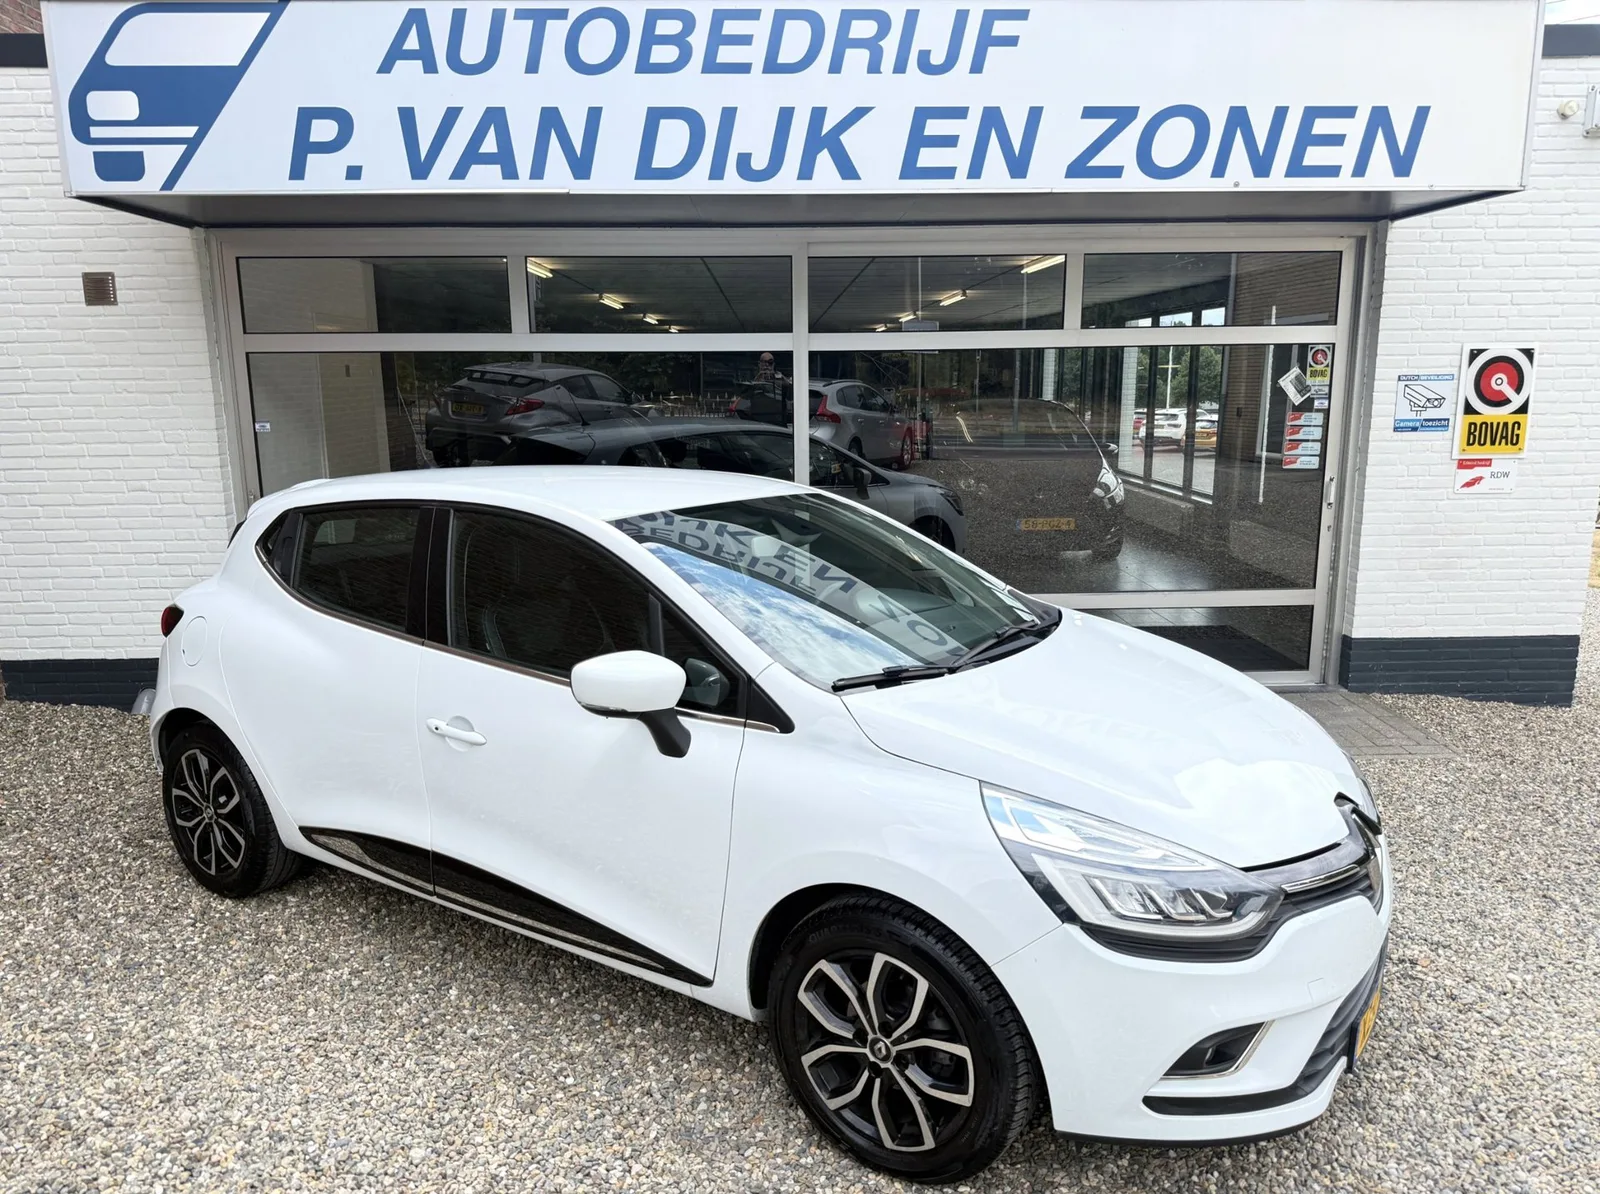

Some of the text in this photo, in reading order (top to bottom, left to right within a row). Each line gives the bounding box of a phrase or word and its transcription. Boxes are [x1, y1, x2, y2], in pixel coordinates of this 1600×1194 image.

[377, 8, 1028, 76] AUTOBEDRIJF
[289, 105, 1429, 182] P. VAN DIJK EN ZONEN
[1309, 369, 1328, 378] BOVAG
[1422, 419, 1448, 427] toezicht
[1466, 421, 1521, 447] BOVAG
[1489, 471, 1510, 479] RDW
